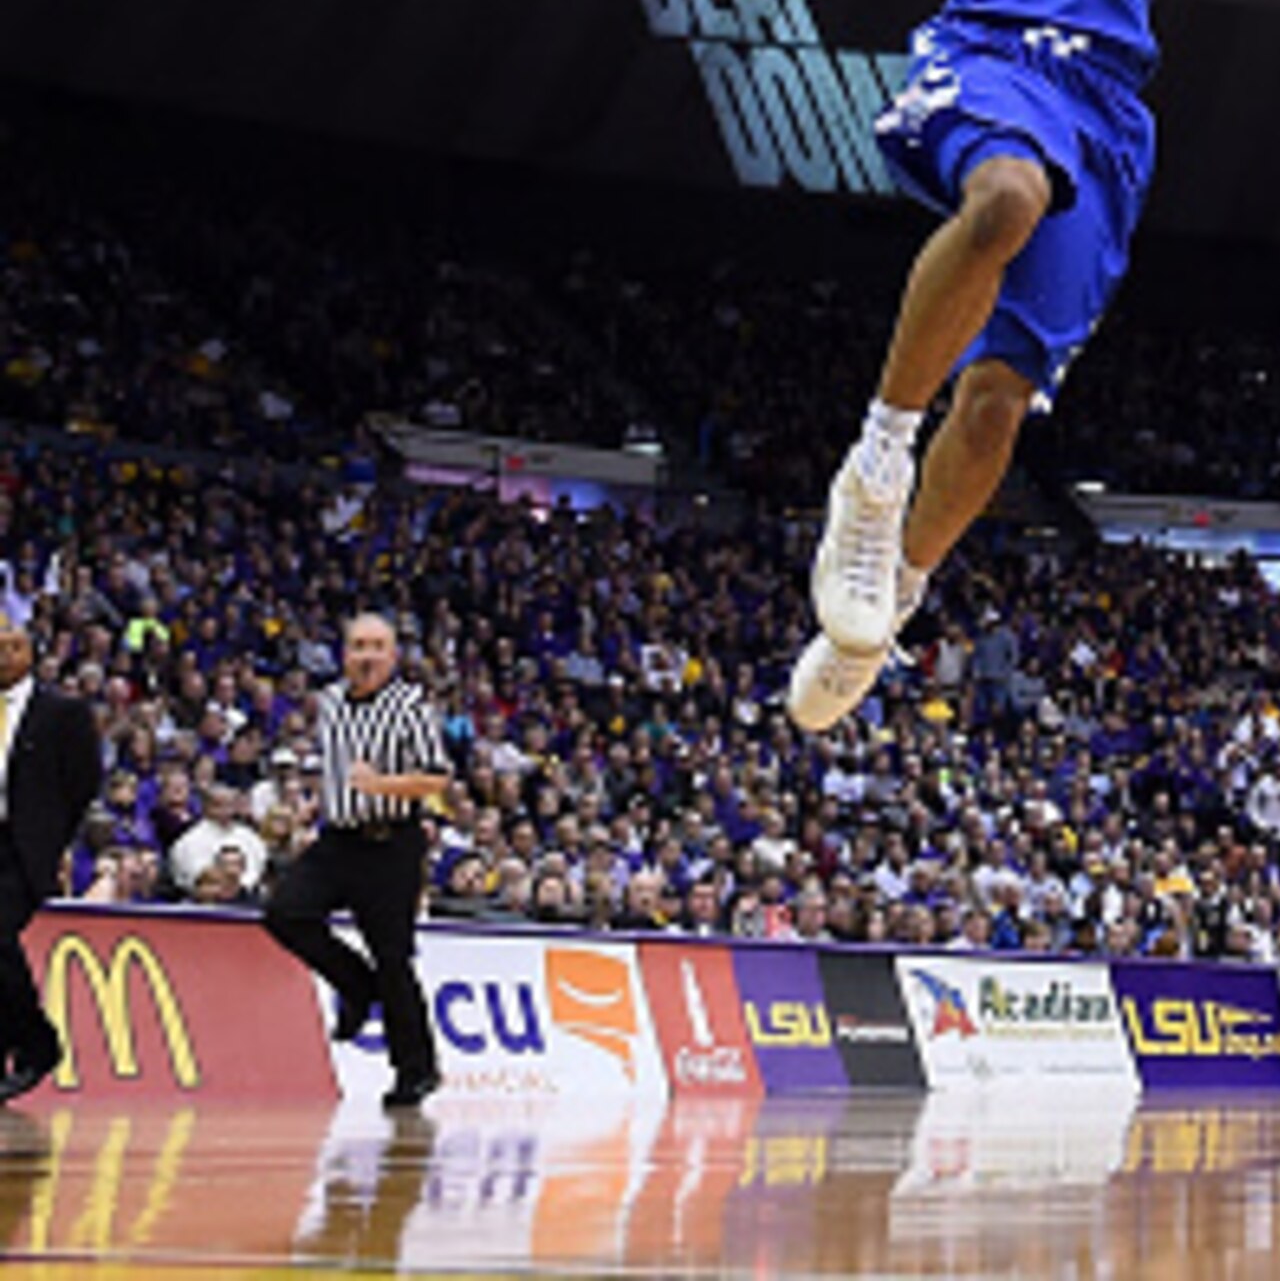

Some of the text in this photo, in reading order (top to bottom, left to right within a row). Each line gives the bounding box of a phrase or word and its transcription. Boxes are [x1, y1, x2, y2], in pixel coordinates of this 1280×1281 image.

[690, 41, 914, 196] DOM
[744, 1000, 833, 1048] LSU
[978, 976, 1111, 1023] Acadian
[1121, 996, 1221, 1056] LSU
